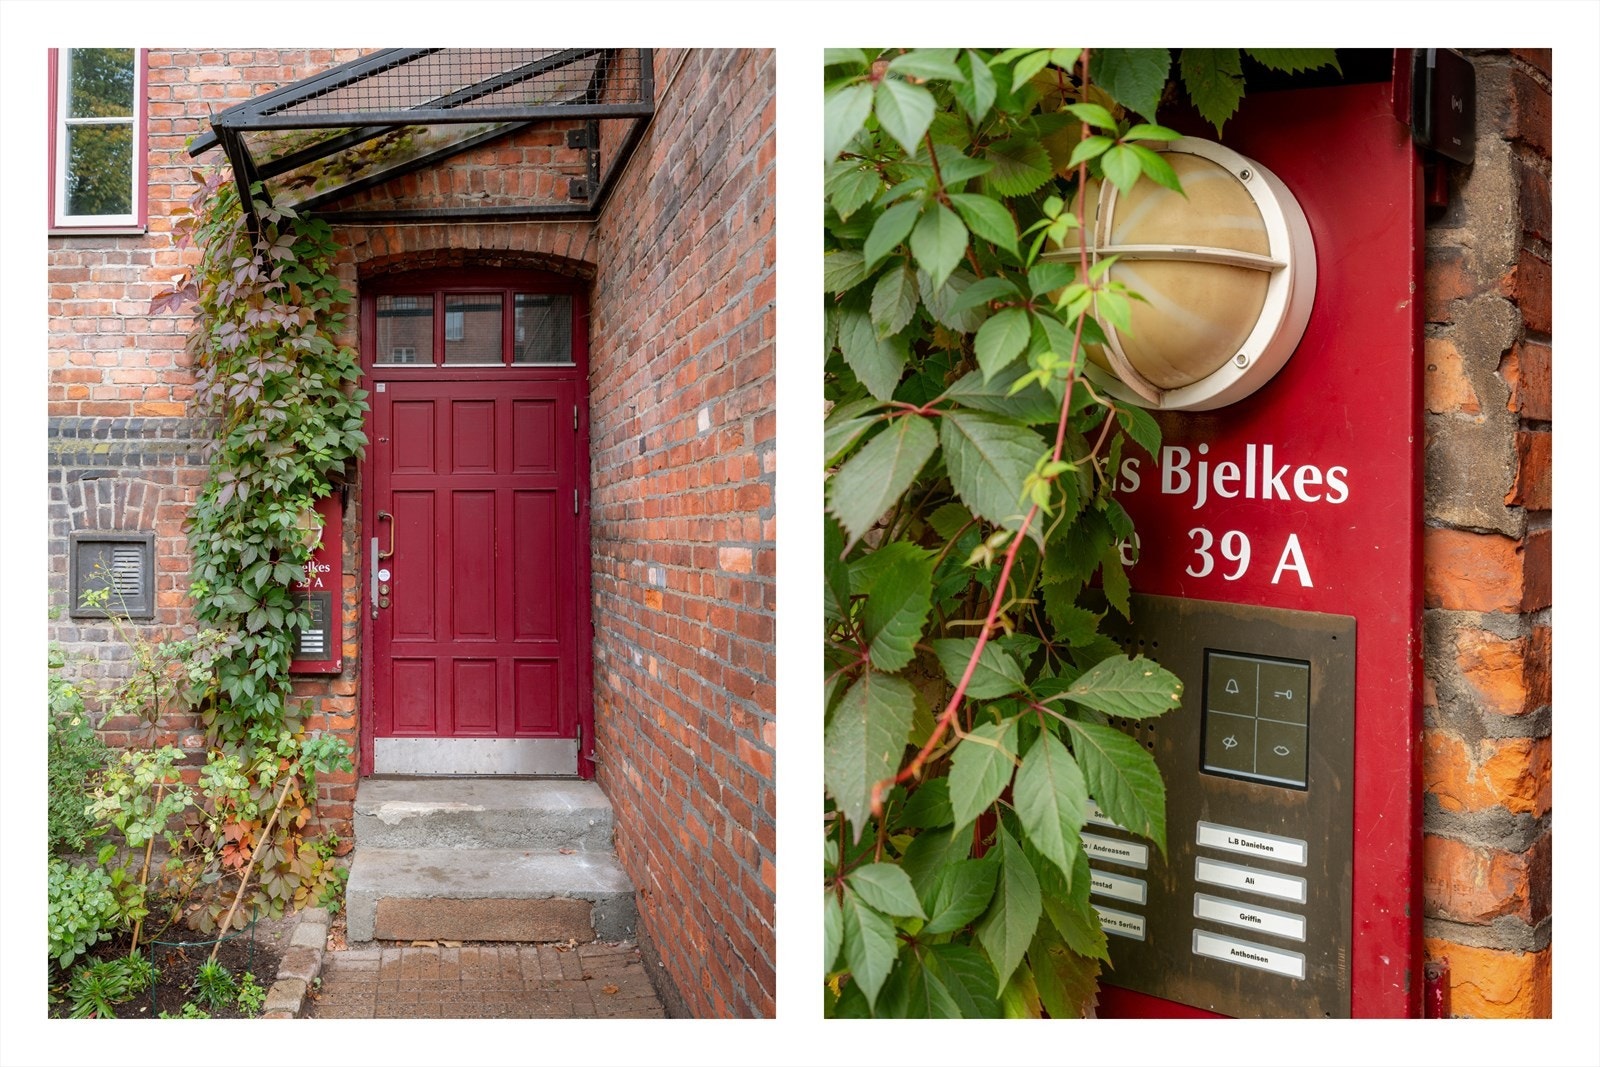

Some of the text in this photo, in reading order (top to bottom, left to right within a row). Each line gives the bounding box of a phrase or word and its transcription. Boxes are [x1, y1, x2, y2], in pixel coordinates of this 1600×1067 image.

[1161, 443, 1349, 510] Bjelkes
[1185, 527, 1251, 581] 39
[1271, 533, 1314, 588] A
[314, 577, 323, 588] A
[1093, 844, 1130, 856] Andreassen
[1228, 837, 1274, 852] L.B Danielsen
[1245, 877, 1255, 886] Ali
[1239, 913, 1262, 924] Griffin
[1230, 948, 1269, 964] Anthonisen
